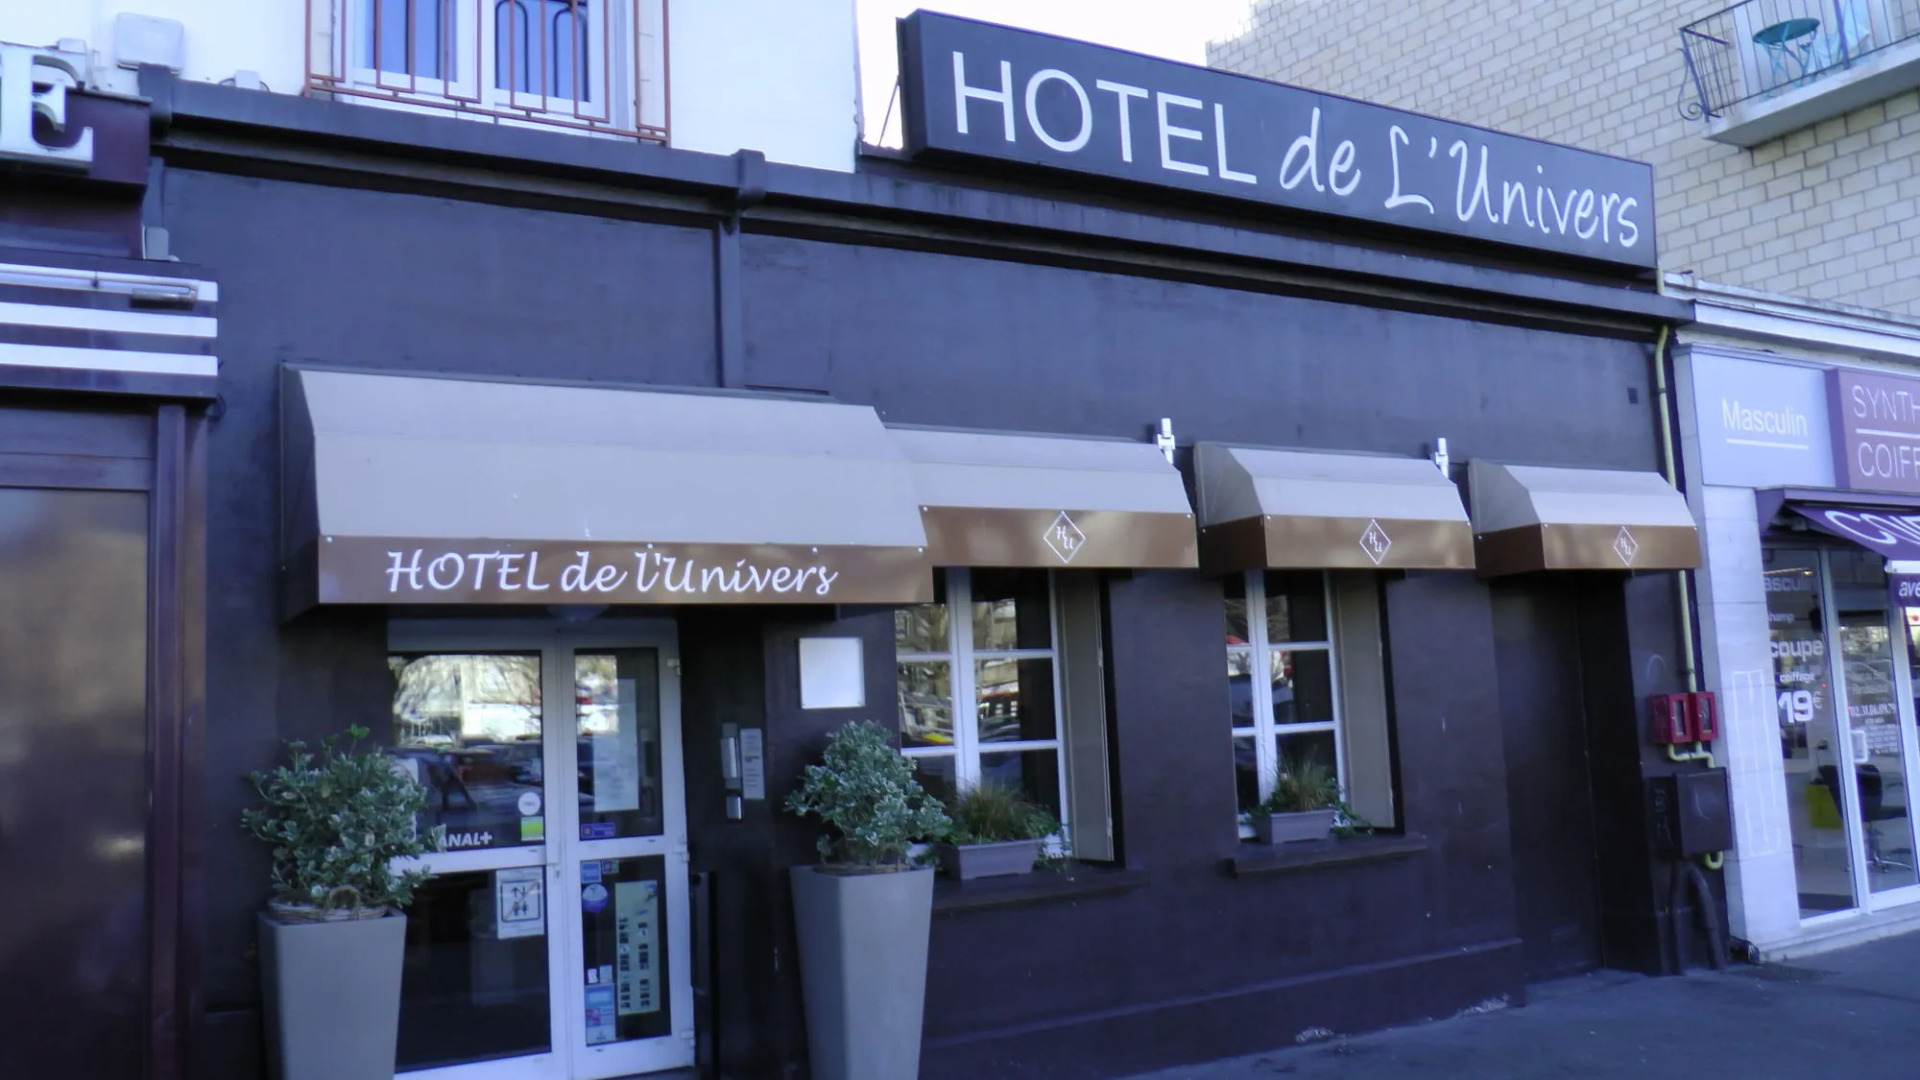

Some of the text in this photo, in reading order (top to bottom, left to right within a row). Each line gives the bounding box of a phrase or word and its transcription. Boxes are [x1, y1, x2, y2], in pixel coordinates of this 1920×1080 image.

[952, 50, 1639, 247] HOTEL de L'Univers
[1722, 399, 1808, 437] Masculin
[386, 549, 549, 593] HOTEL
[561, 551, 628, 592] de
[1770, 640, 1824, 661] coupe
[438, 830, 493, 847] ANAL+
